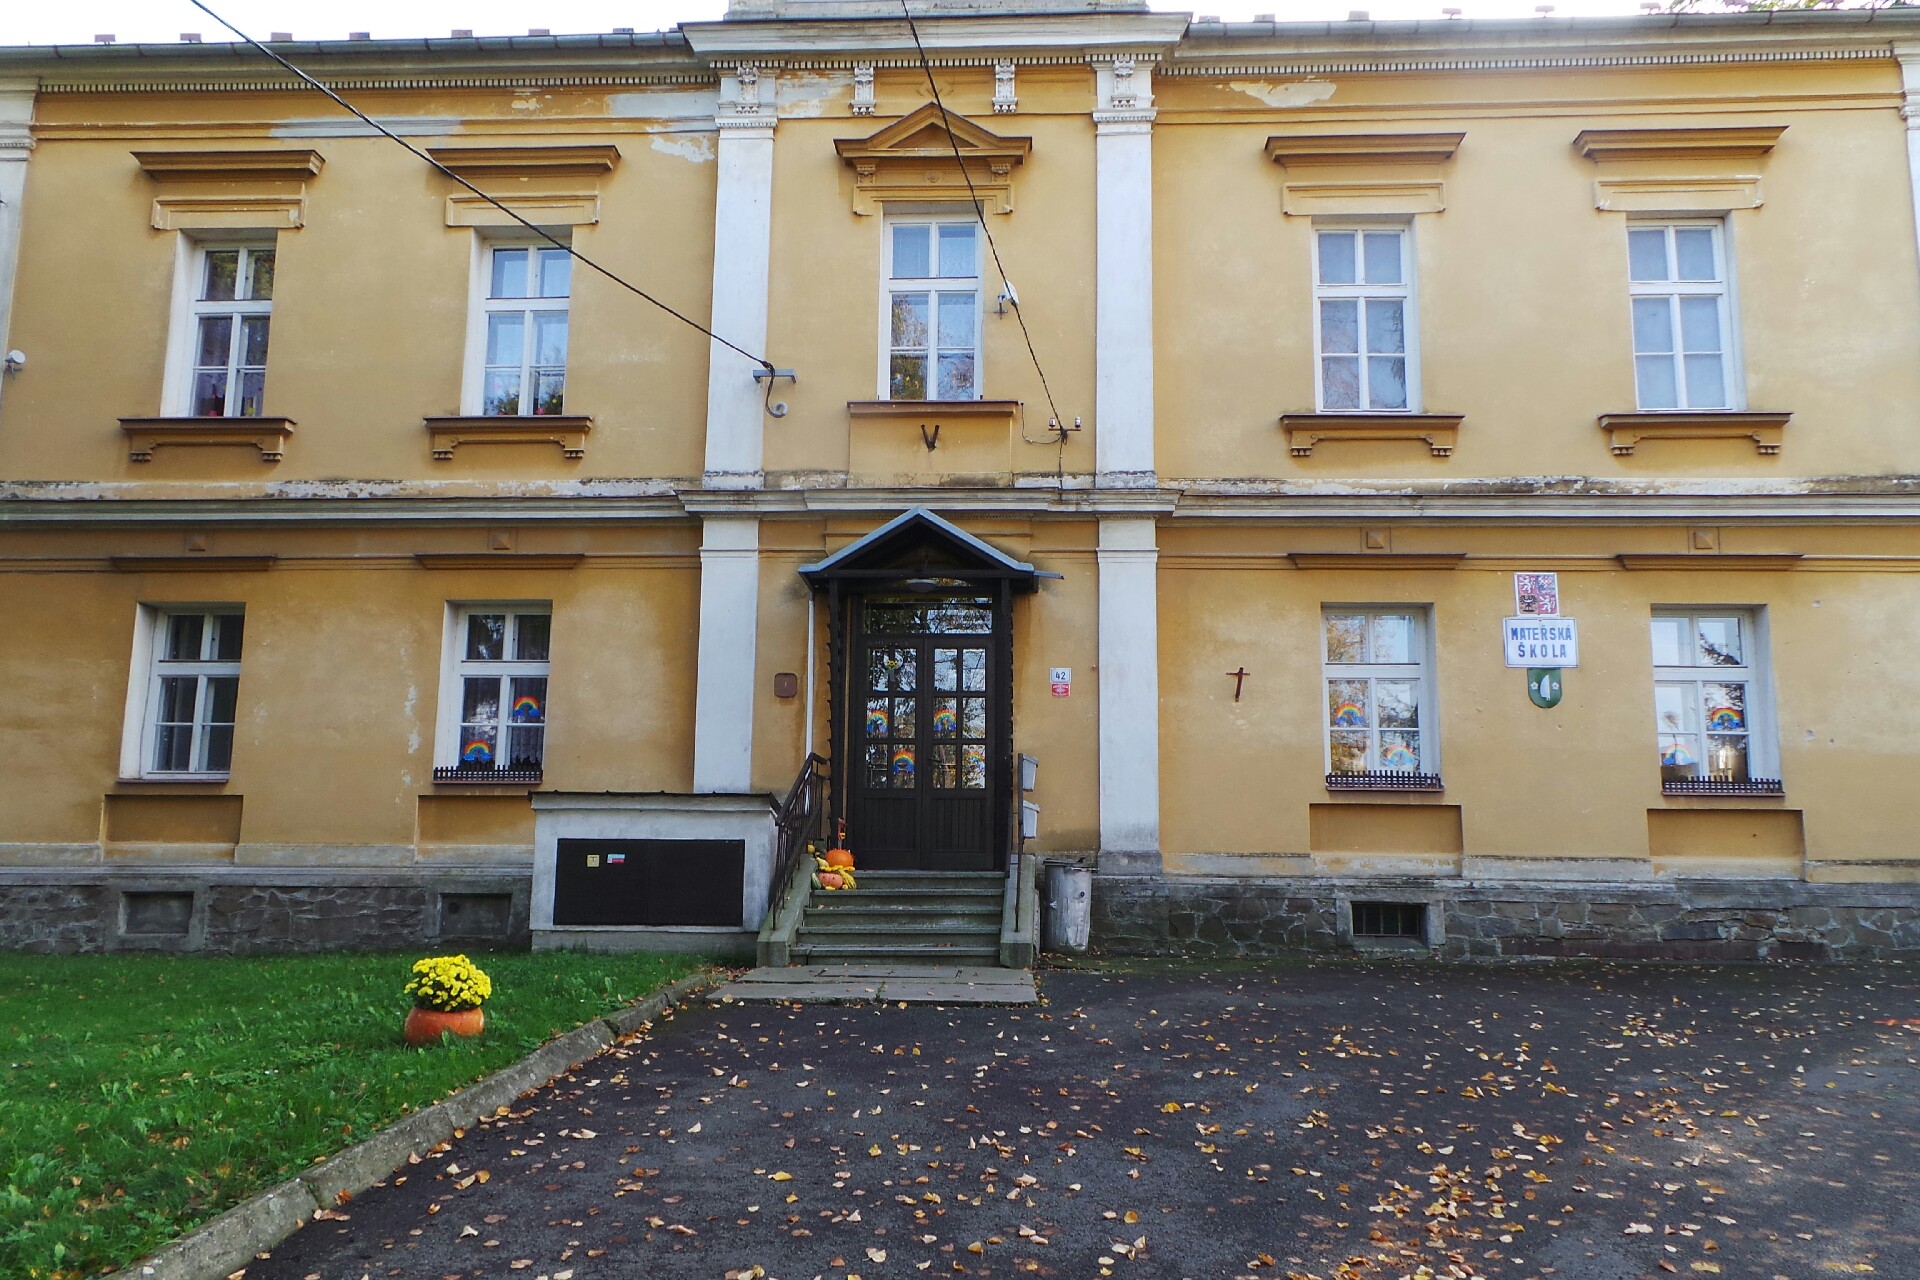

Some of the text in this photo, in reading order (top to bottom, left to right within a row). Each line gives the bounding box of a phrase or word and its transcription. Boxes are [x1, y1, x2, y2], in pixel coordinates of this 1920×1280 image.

[1511, 625, 1572, 641] MATEŘSKÁ
[1518, 642, 1567, 658] ŠKOLA
[1055, 671, 1066, 680] 42
